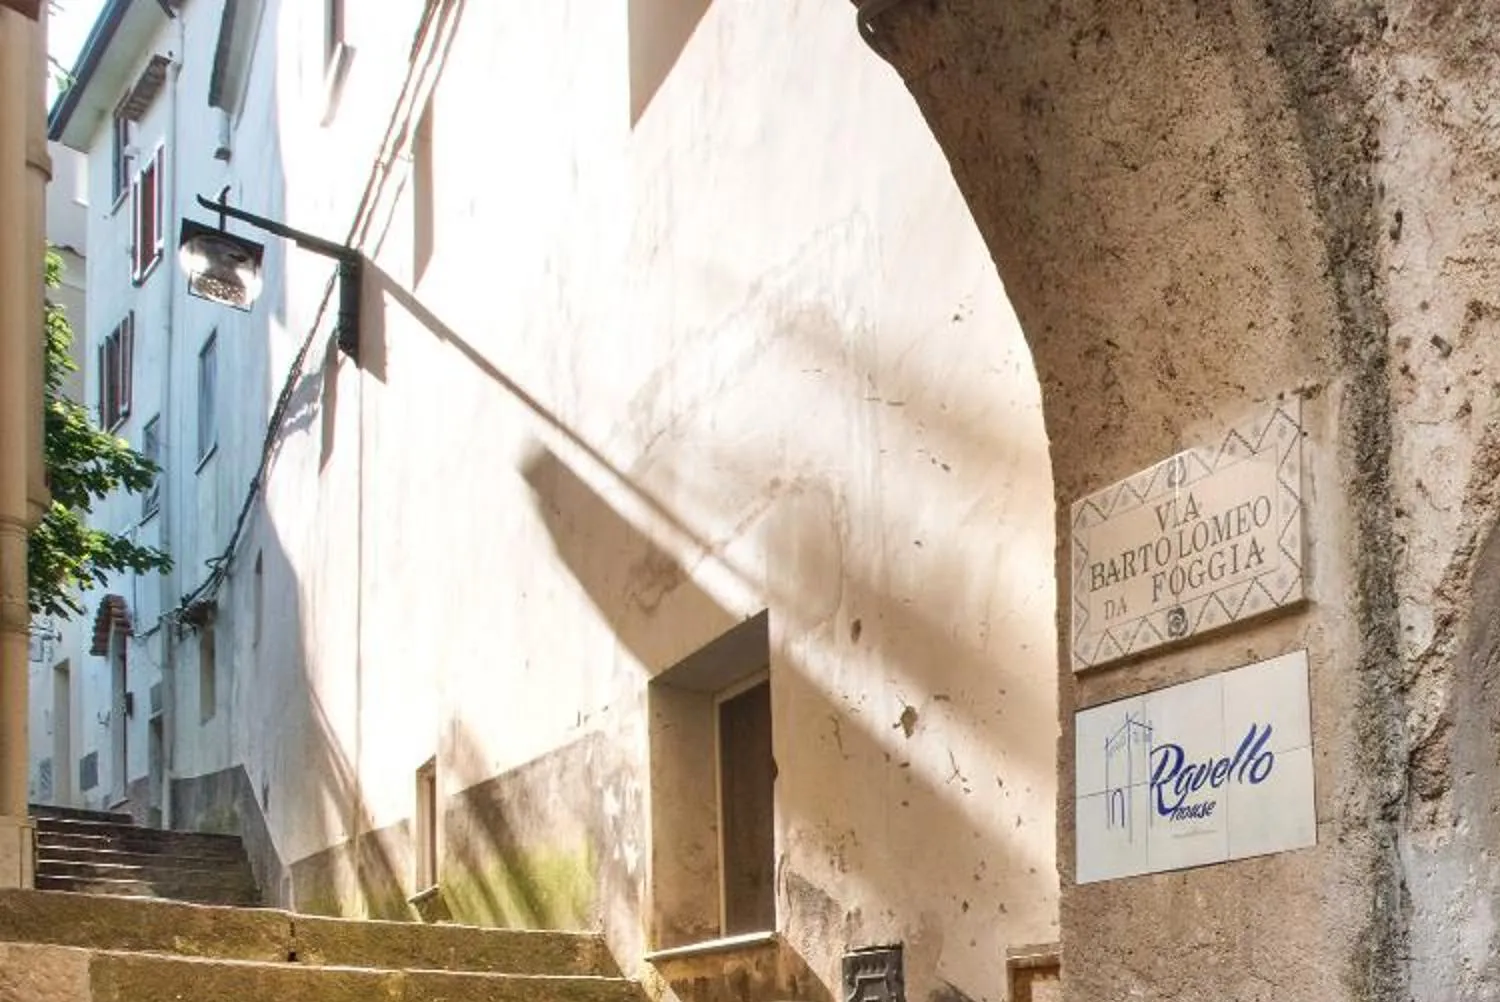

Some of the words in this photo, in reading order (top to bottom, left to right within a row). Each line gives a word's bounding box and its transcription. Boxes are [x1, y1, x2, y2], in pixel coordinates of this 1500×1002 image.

[1090, 495, 1271, 592] BARTOLOMEO
[1154, 492, 1200, 532] VIA
[1104, 598, 1128, 620] DA
[1152, 537, 1265, 603] FOGGIA
[1150, 723, 1275, 816] Ravello
